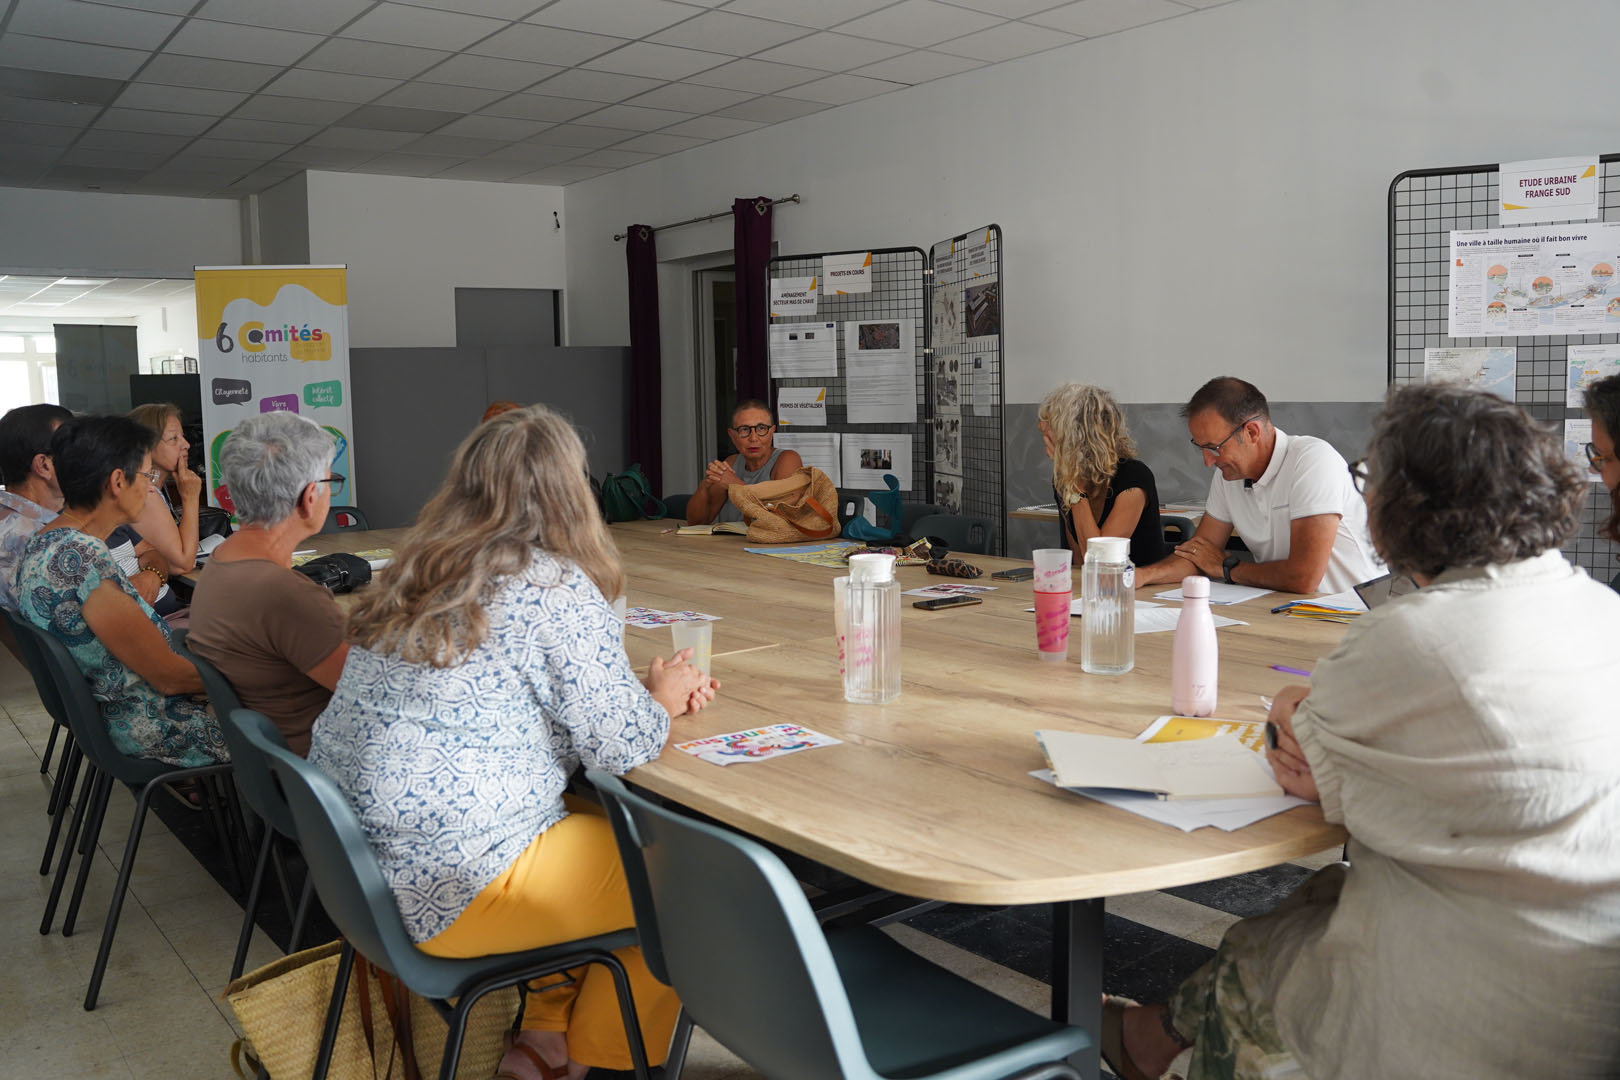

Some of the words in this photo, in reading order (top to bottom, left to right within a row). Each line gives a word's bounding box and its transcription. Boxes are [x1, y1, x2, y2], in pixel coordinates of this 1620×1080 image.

[1519, 178, 1543, 188] ETUDE
[1544, 175, 1577, 186] URBAINE
[1525, 189, 1554, 198] FRANGE
[1555, 187, 1571, 196] SUD
[1469, 239, 1482, 247] ville
[1487, 238, 1503, 246] taille
[1504, 236, 1531, 245] humaine
[1532, 235, 1540, 243] où
[1559, 234, 1571, 242] bon
[216, 322, 234, 353] 6
[242, 351, 288, 363] habitants
